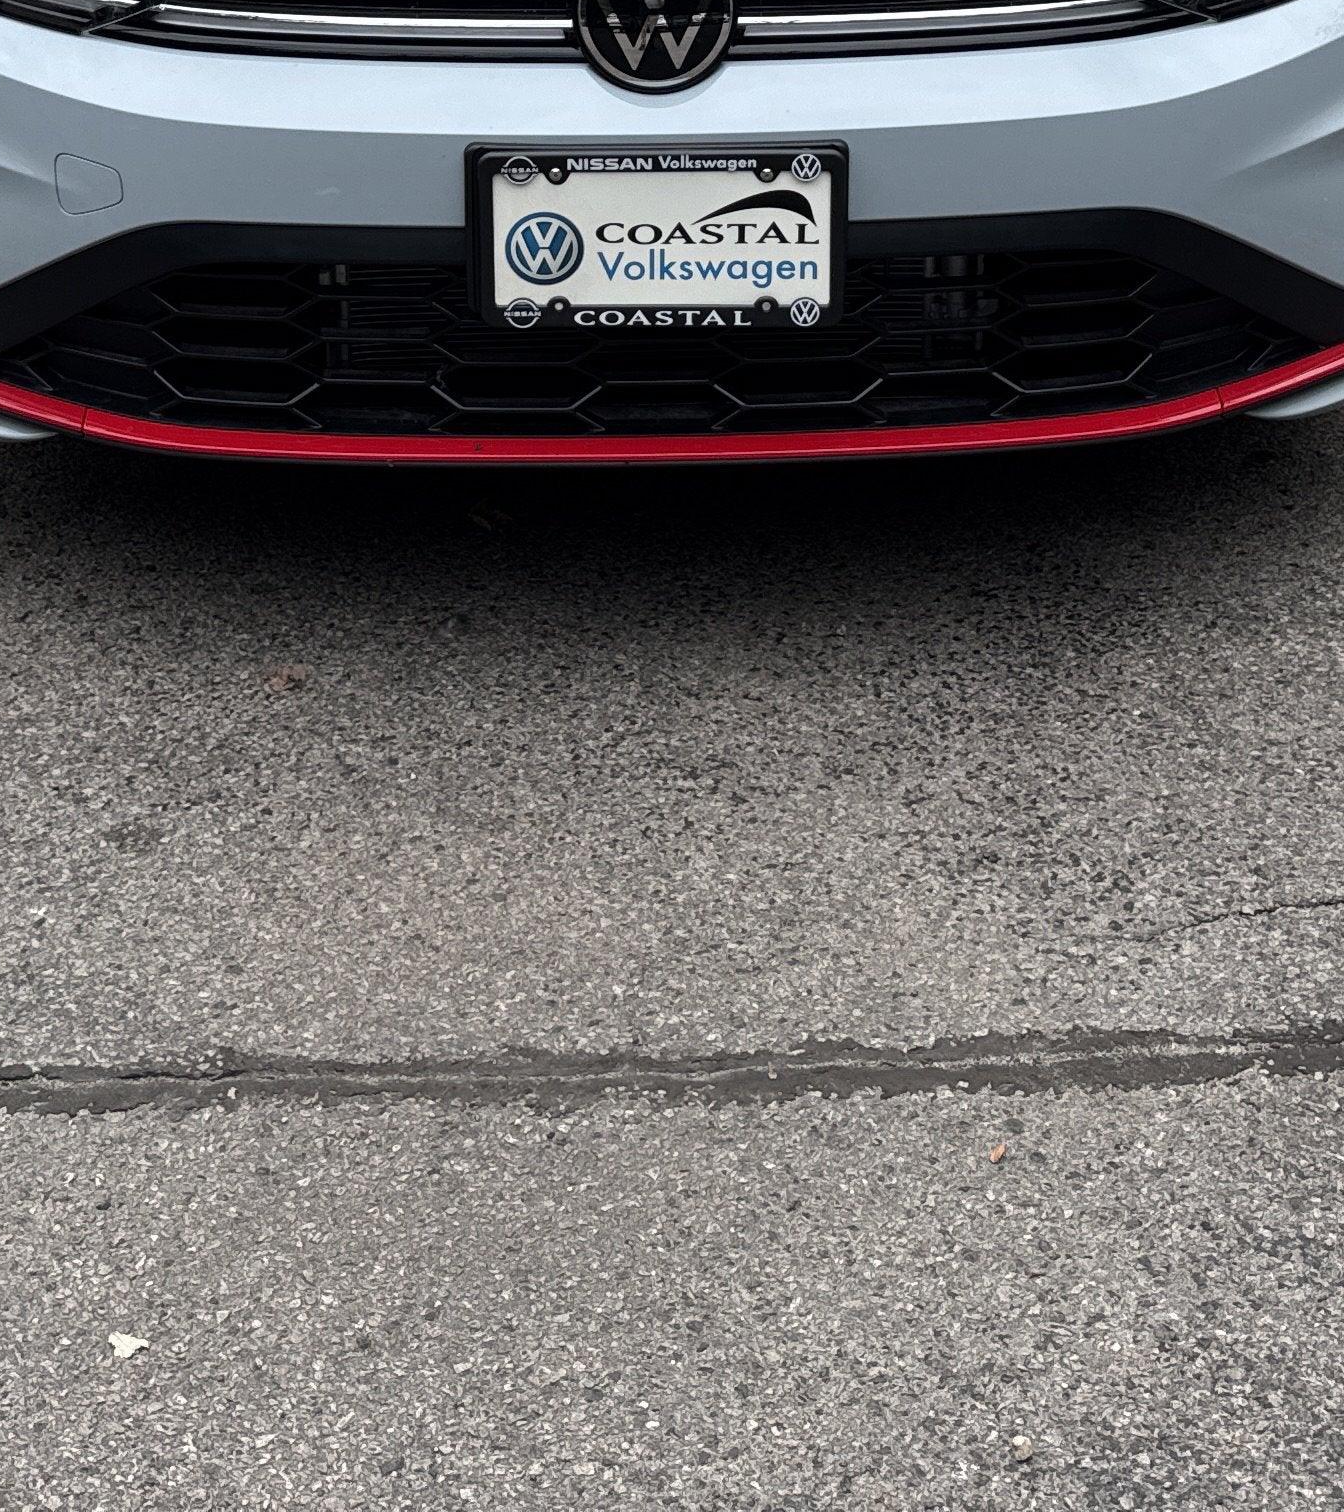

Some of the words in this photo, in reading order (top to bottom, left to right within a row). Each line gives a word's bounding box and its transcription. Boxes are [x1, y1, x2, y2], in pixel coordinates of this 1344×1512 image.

[566, 158, 653, 171] NISSAN
[657, 155, 758, 172] Volkswagen
[595, 221, 820, 245] COASTAL
[597, 249, 818, 289] Volkswagen
[573, 309, 752, 327] COASTAL
